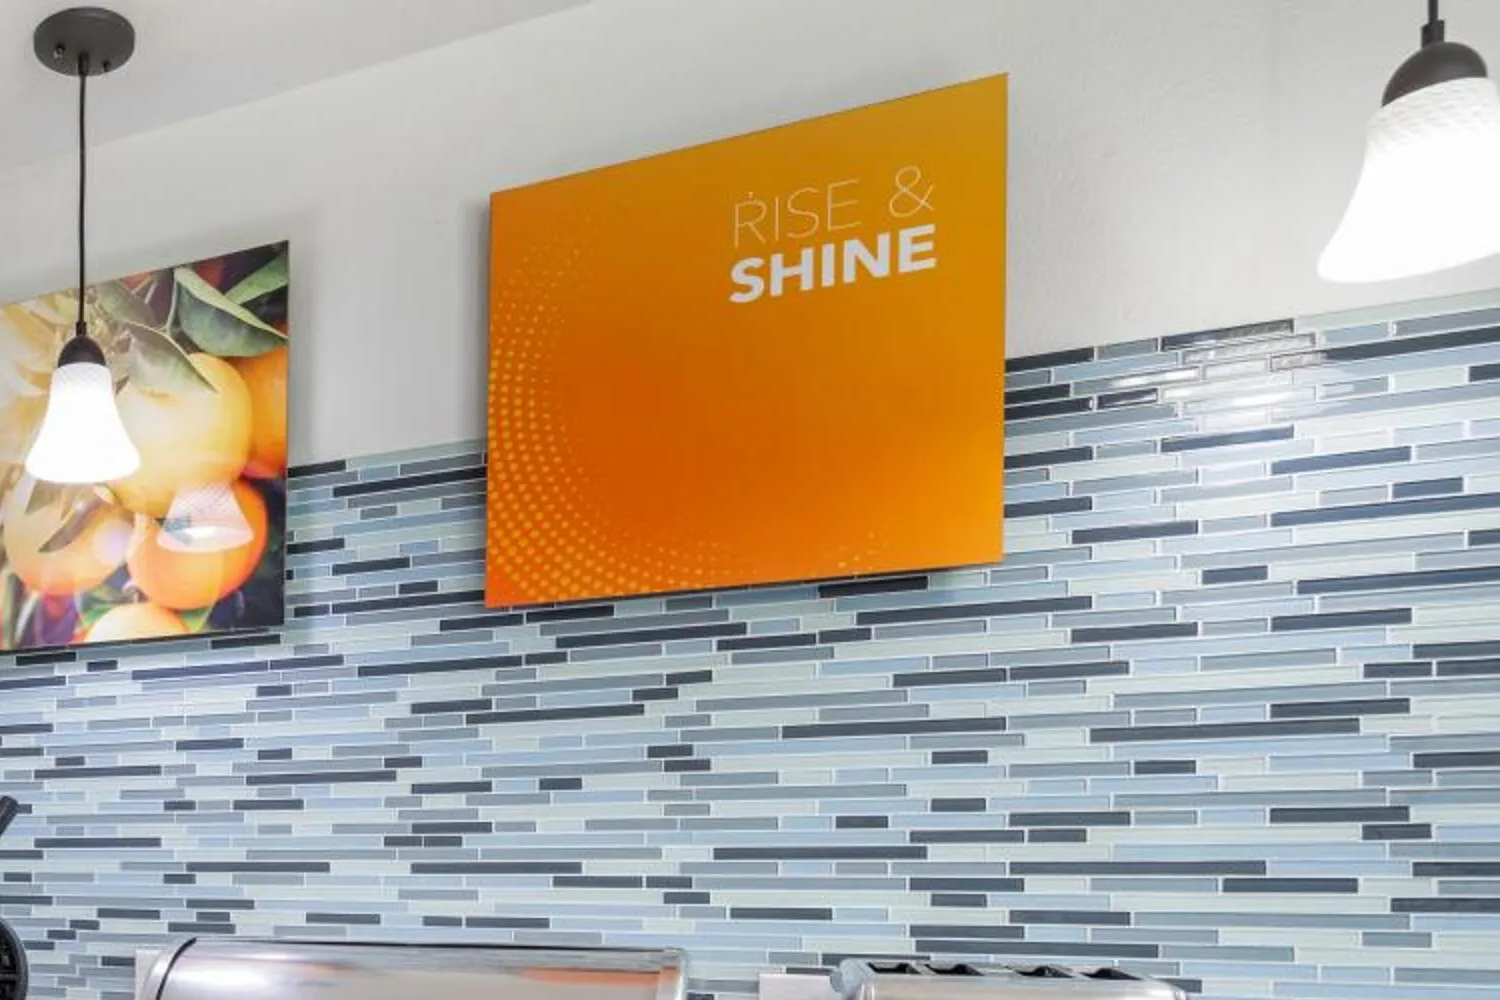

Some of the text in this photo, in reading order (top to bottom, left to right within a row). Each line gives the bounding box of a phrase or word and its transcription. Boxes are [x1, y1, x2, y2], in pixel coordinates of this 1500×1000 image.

[734, 166, 934, 249] RISE &
[729, 223, 937, 303] SHINE
